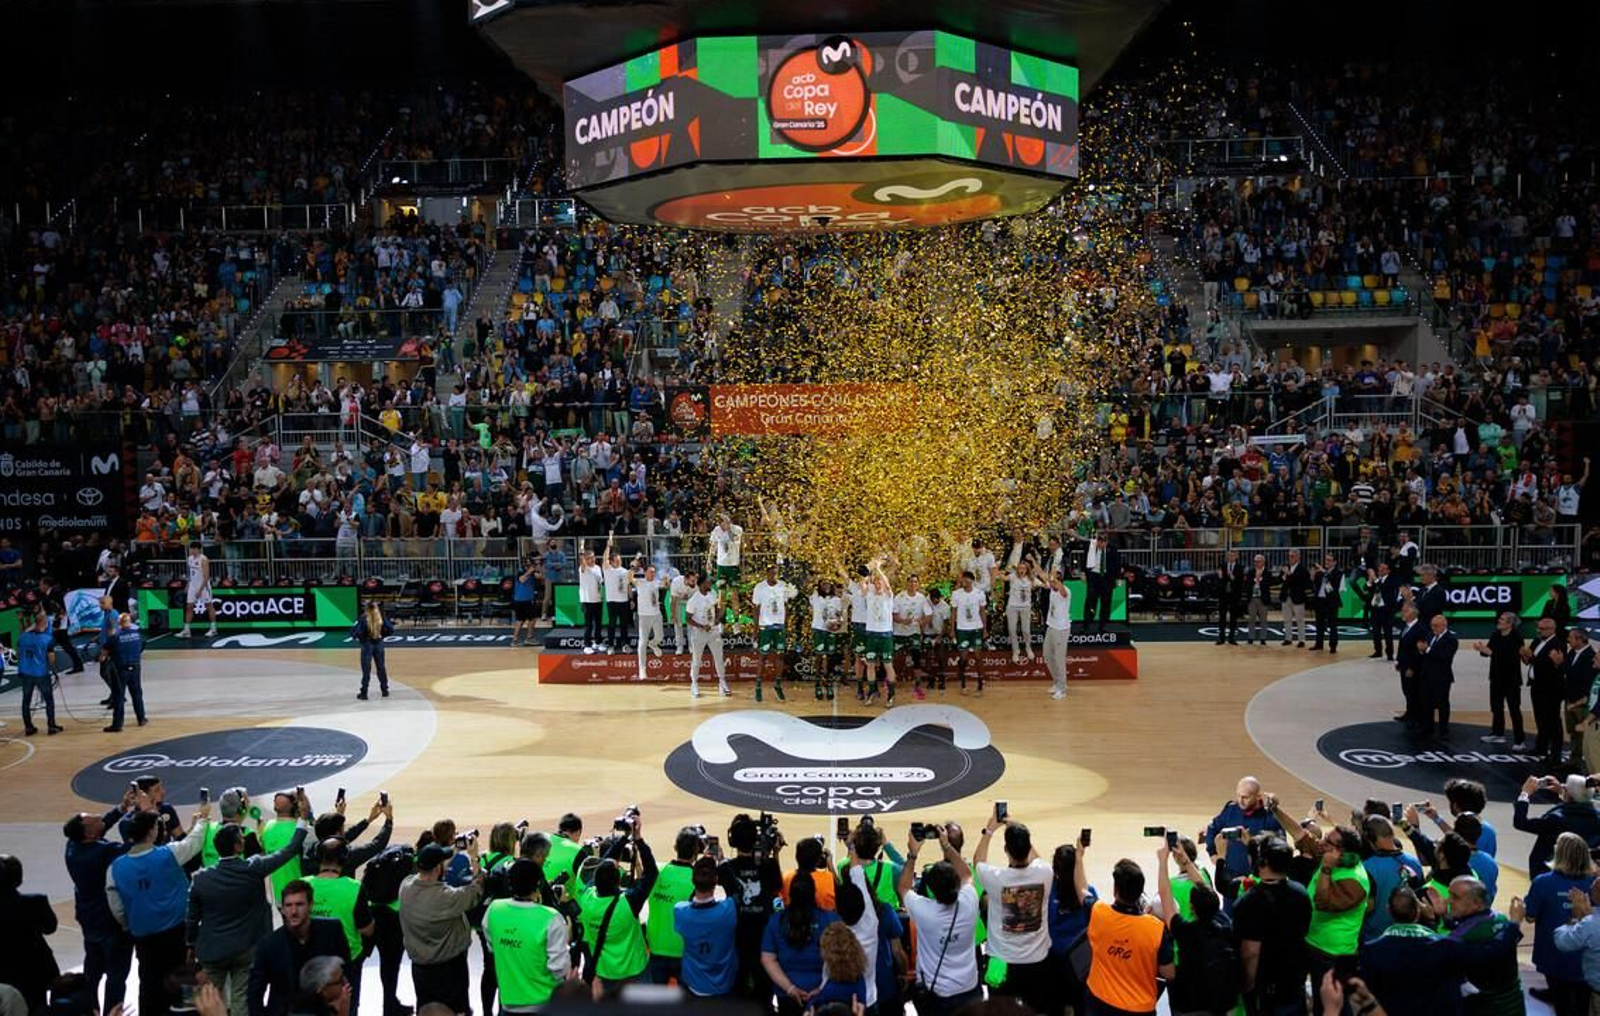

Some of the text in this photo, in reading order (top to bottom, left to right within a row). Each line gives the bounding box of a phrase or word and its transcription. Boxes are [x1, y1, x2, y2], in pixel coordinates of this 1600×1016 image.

[792, 73, 815, 84] acb
[783, 84, 829, 100] Copa
[804, 101, 838, 118] Rey
[954, 82, 1062, 132] CAMPEÓN
[575, 89, 674, 145] CAMPEÓN
[741, 204, 842, 214] acb
[714, 393, 808, 408] CAMPEONES
[15, 459, 61, 468] Cabildo de
[15, 468, 71, 477] Gran Canaria
[39, 516, 107, 530] mediolanum
[343, 632, 516, 644] ovistar
[103, 753, 348, 773] mediolanum
[1338, 748, 1549, 769] mediolan
[743, 771, 798, 779] Gran
[803, 771, 894, 779] Canaria
[775, 785, 882, 798] Copa
[783, 797, 900, 812] del Rey
[500, 937, 523, 949] MMCC
[1107, 944, 1133, 960] ORG
